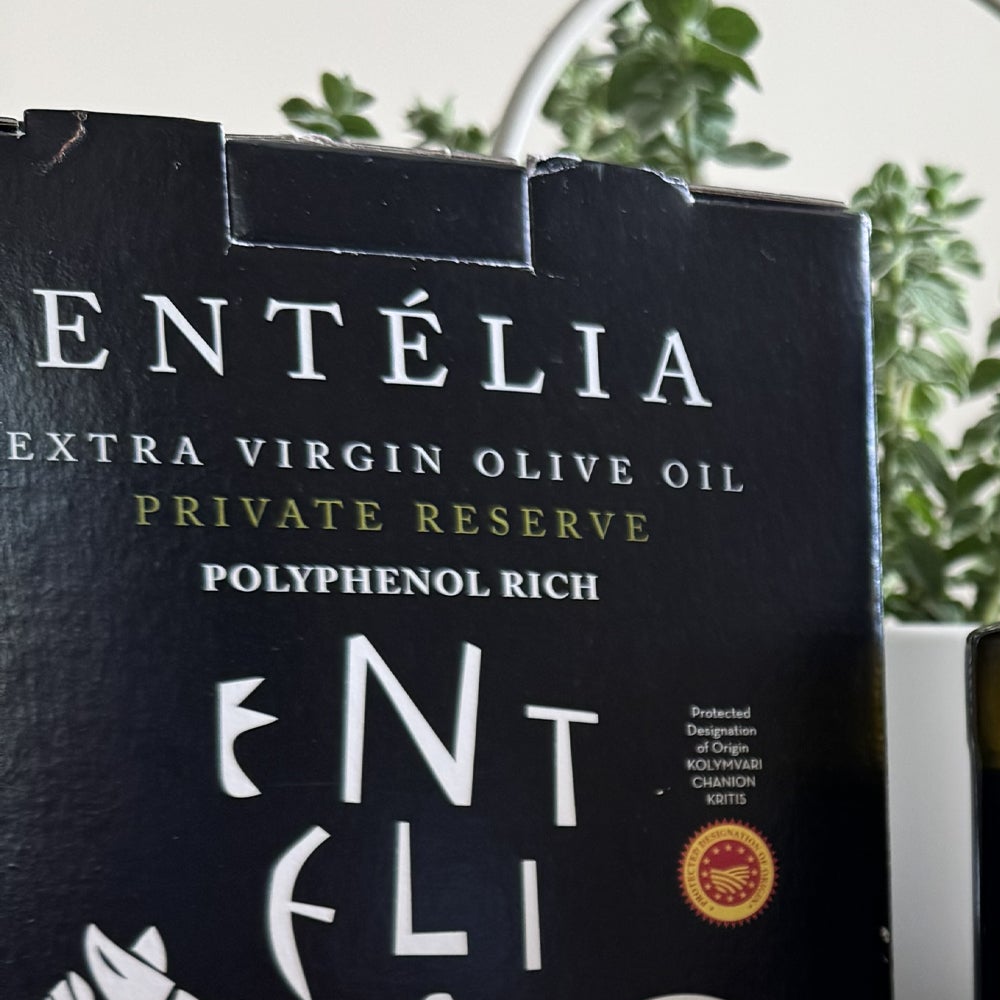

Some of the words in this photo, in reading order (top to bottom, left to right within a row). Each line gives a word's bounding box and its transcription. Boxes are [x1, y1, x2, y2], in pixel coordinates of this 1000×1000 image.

[33, 289, 712, 406] ENTÉLIA
[6, 431, 203, 466] EXTRA
[237, 438, 442, 474] VIRGIN
[475, 449, 633, 485] OLIVE
[662, 461, 744, 493] OIL
[135, 494, 382, 531] PRIVATE
[416, 502, 650, 542] RESERVE
[202, 563, 490, 597] POLYPHENOL
[501, 570, 599, 600] RICH
[691, 706, 751, 719] Protected
[686, 724, 757, 739] Designation
[696, 741, 709, 754] of
[711, 741, 749, 756] Origin
[686, 759, 763, 771] KOLYMVARI
[692, 776, 756, 789] CHANION
[706, 793, 747, 805] KRITIS
